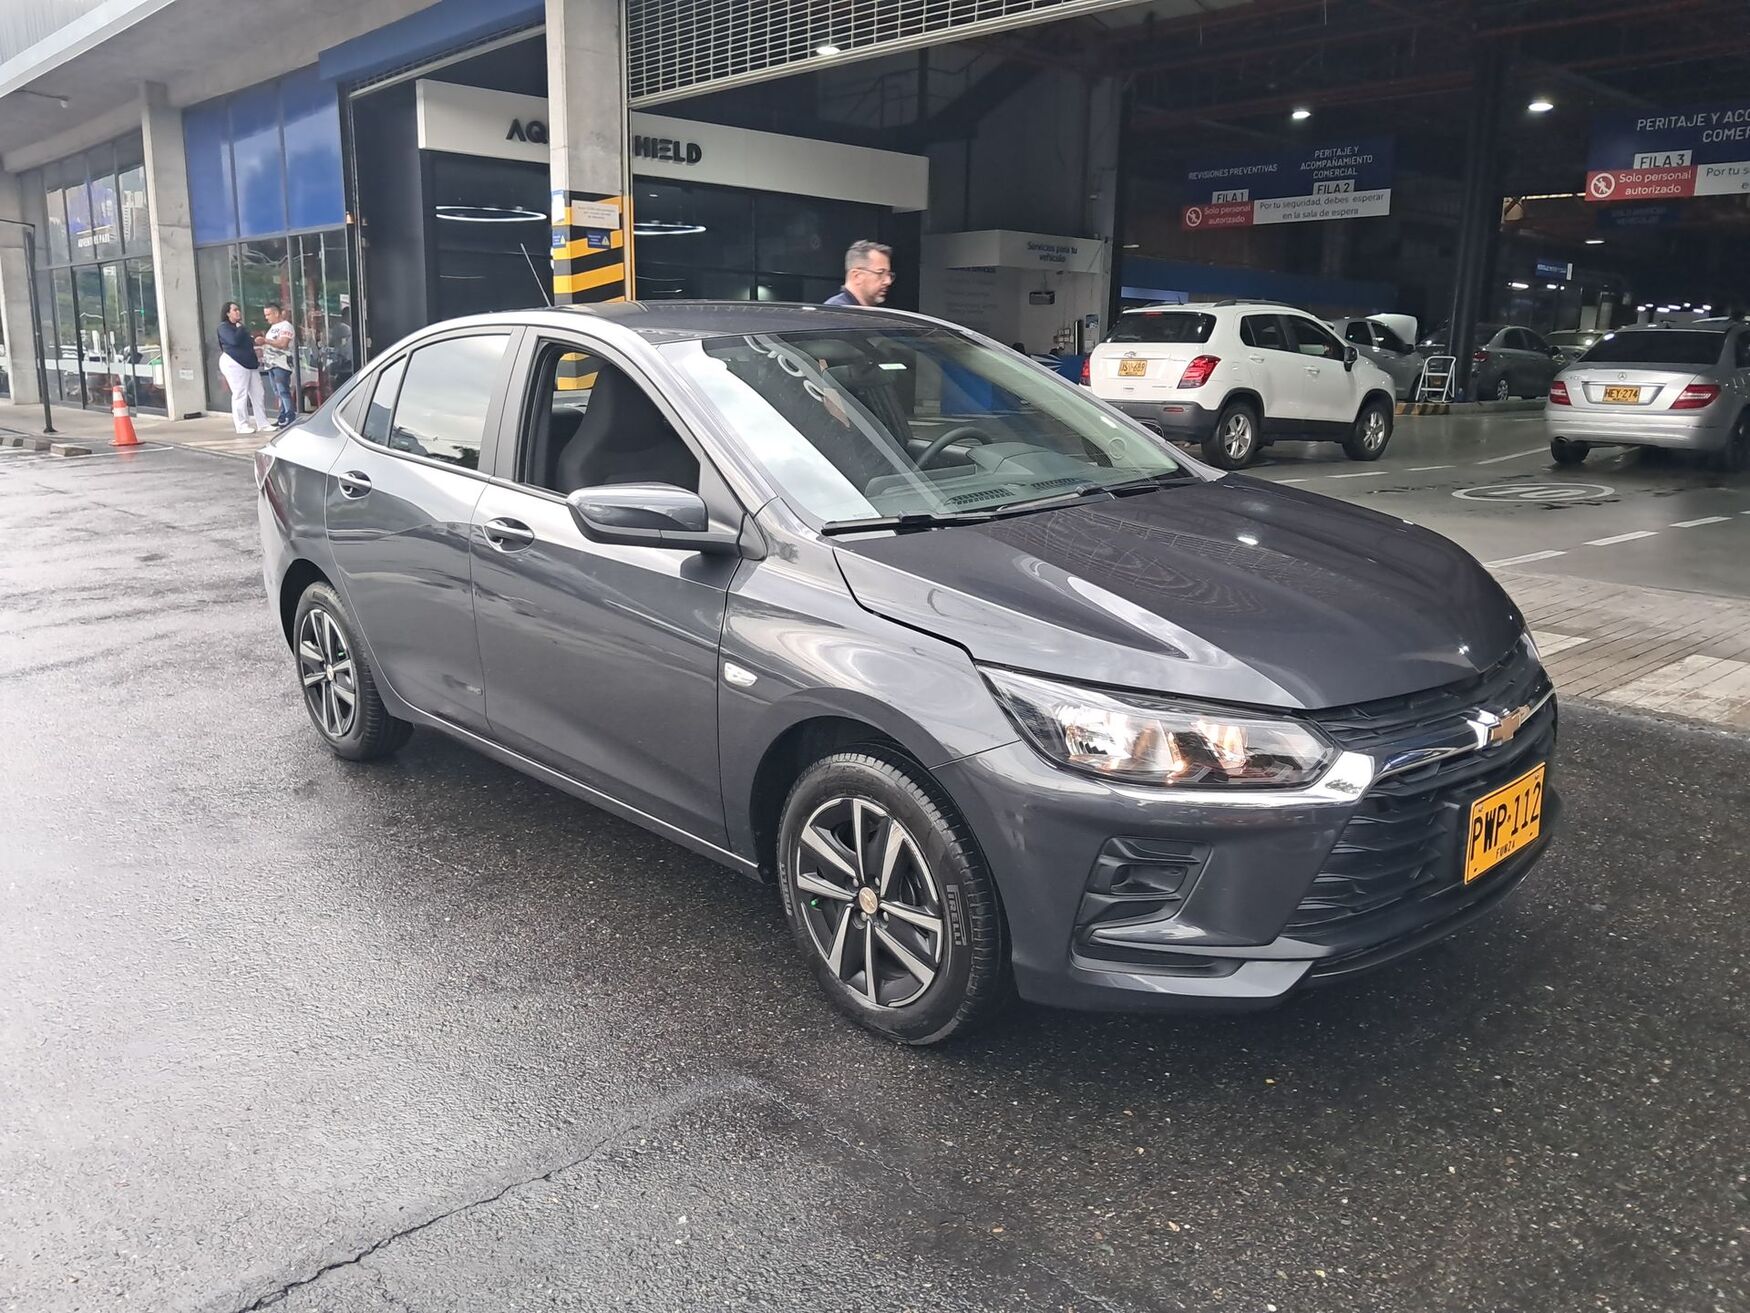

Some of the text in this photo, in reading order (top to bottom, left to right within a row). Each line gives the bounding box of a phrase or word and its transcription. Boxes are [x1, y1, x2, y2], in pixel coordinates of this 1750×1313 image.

[1637, 113, 1707, 131] PERITAJE
[1711, 112, 1720, 125] Y
[505, 118, 703, 165] AQ HIELD
[1314, 145, 1359, 158] PERITAJE Y
[1300, 155, 1373, 170] ACOMPAÑAMIENTO
[1640, 154, 1685, 168] FILA 3
[1188, 163, 1278, 180] REVISIONES PREVENTIVAS
[1313, 167, 1358, 179] COMERCIAL
[1619, 170, 1691, 183] Solo personal
[1706, 167, 1725, 177] Por
[1728, 167, 1739, 176] tu
[1317, 182, 1350, 195] FILA 2
[1625, 184, 1681, 195] autorizado
[1217, 192, 1244, 203] FILA 1
[1324, 196, 1349, 205] debes
[1353, 193, 1384, 203] esperar
[1204, 205, 1251, 215] Solo personal
[1294, 211, 1301, 219] la
[1302, 209, 1317, 218] sala
[1319, 208, 1329, 217] de
[1331, 208, 1359, 217] espera
[1208, 215, 1245, 225] autorizado
[946, 884, 966, 946] PIRELLI
